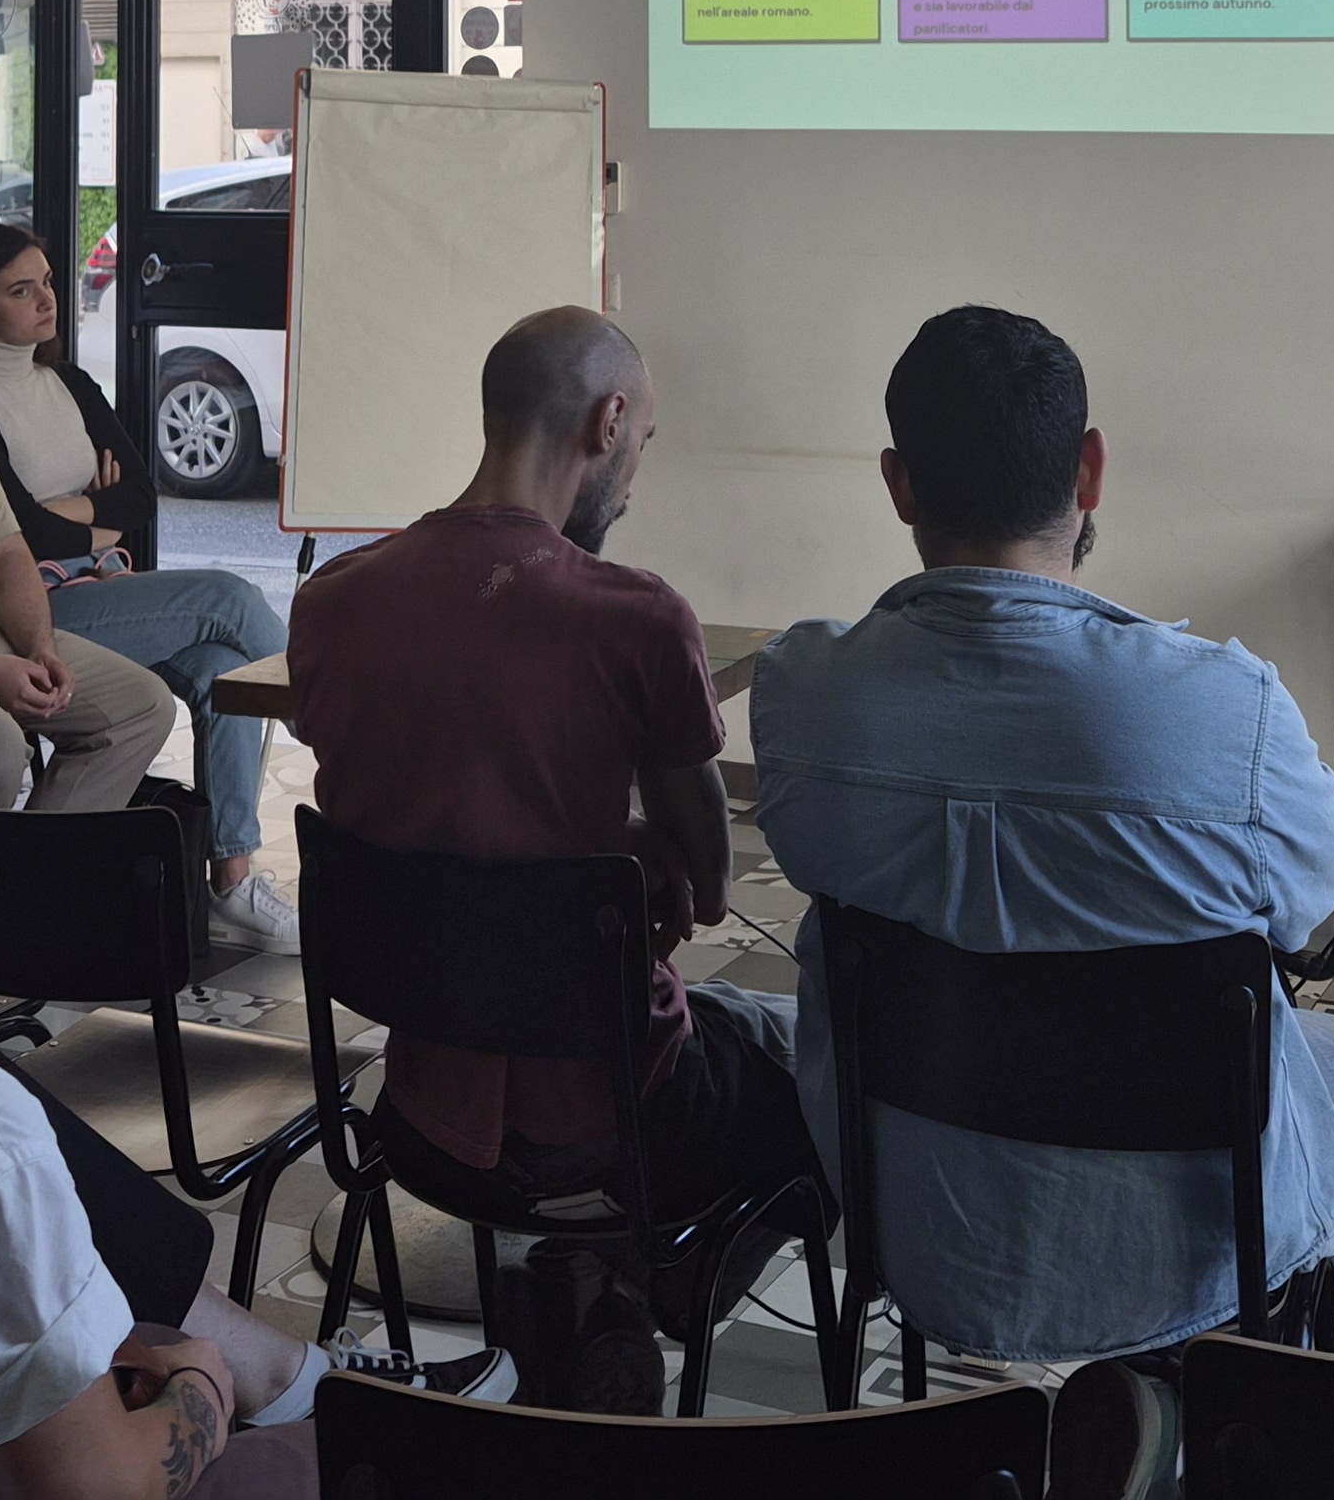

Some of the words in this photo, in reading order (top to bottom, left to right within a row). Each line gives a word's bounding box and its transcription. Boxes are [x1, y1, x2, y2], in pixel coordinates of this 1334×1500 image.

[697, 6, 758, 18] nell'areale
[761, 7, 812, 17] romano.
[913, 2, 922, 12] e
[924, 1, 943, 11] sia
[946, 0, 1009, 11] lavorabile
[1012, 0, 1034, 11] dai
[1143, 0, 1209, 13] prossimo
[1212, 0, 1275, 10] autunno.
